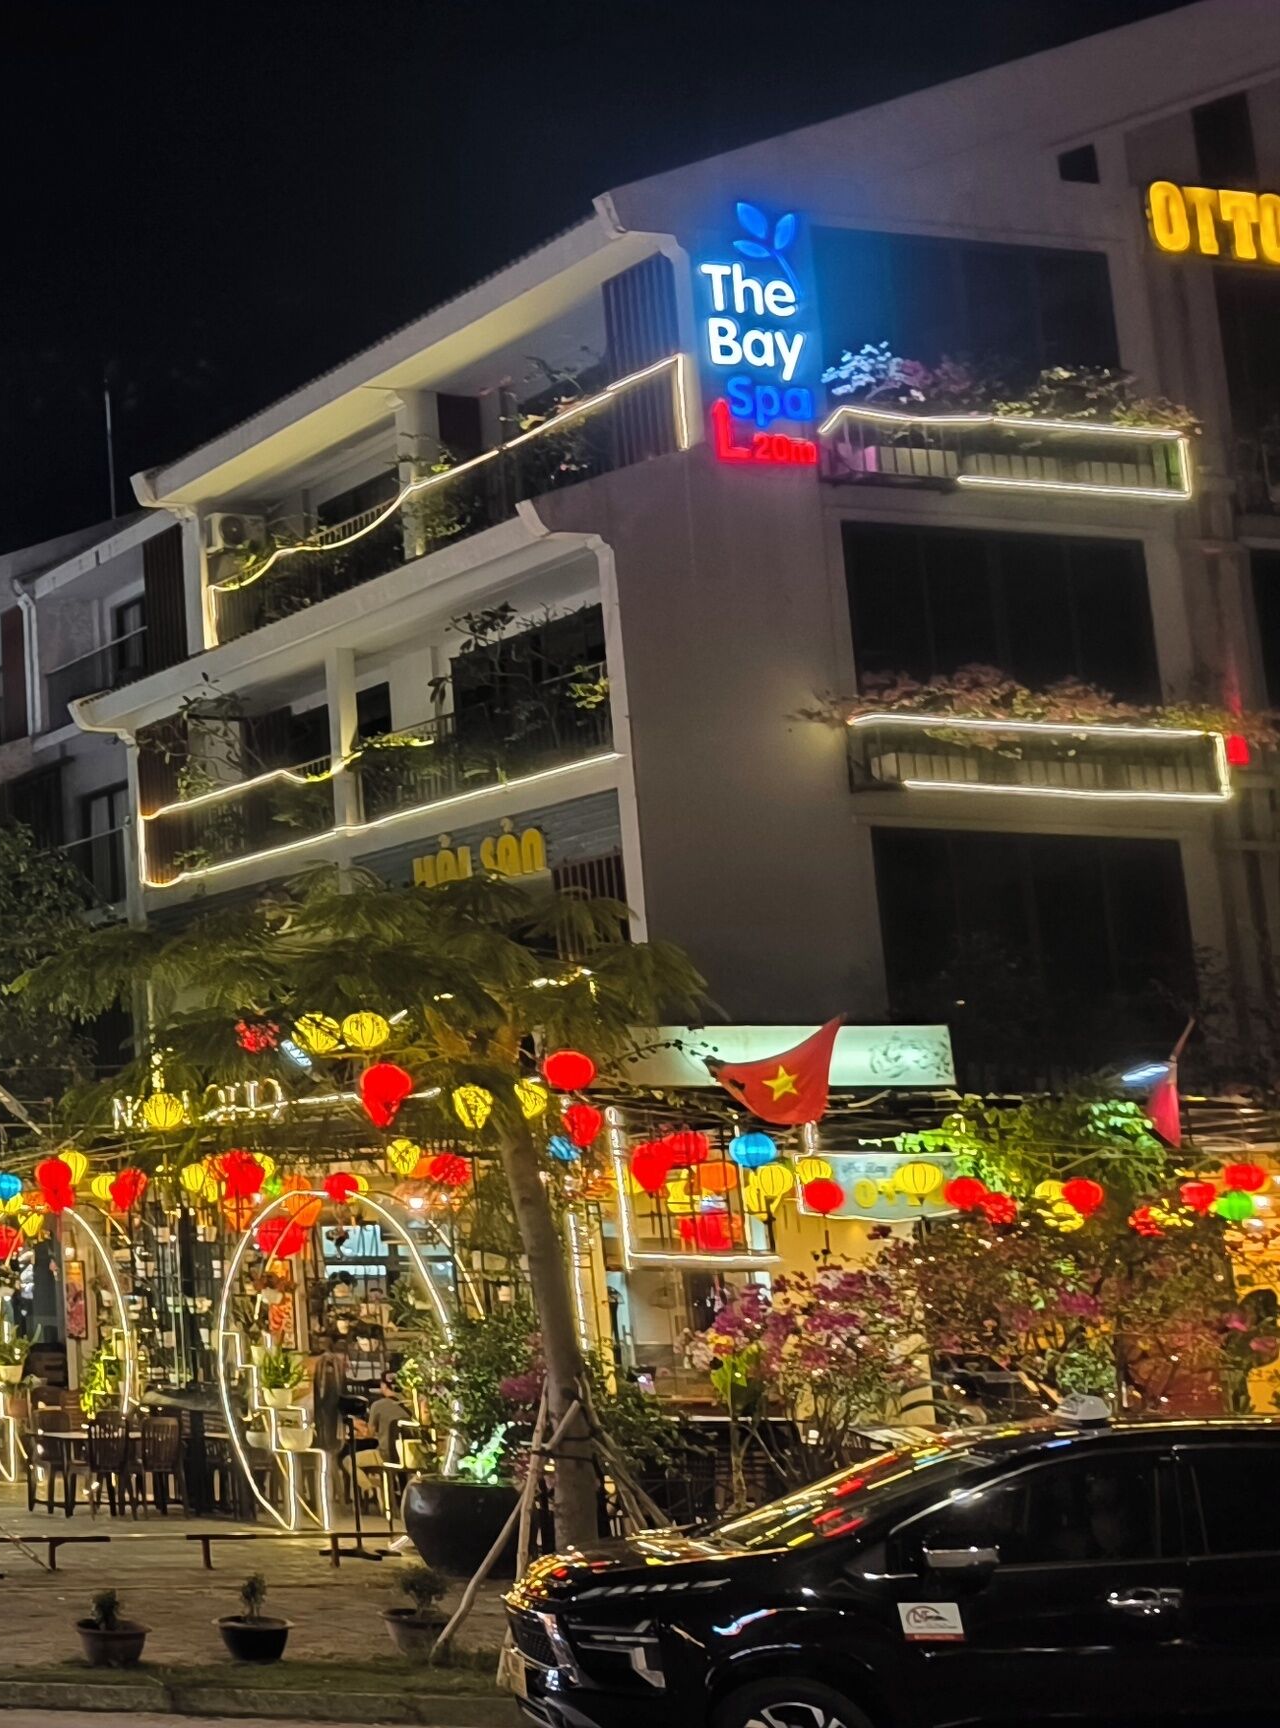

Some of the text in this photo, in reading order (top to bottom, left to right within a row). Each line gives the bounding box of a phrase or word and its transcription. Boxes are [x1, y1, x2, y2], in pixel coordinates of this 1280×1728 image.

[700, 263, 797, 317] The
[708, 317, 804, 381] Bay
[727, 375, 813, 428] Spa
[752, 432, 818, 464] 20m
